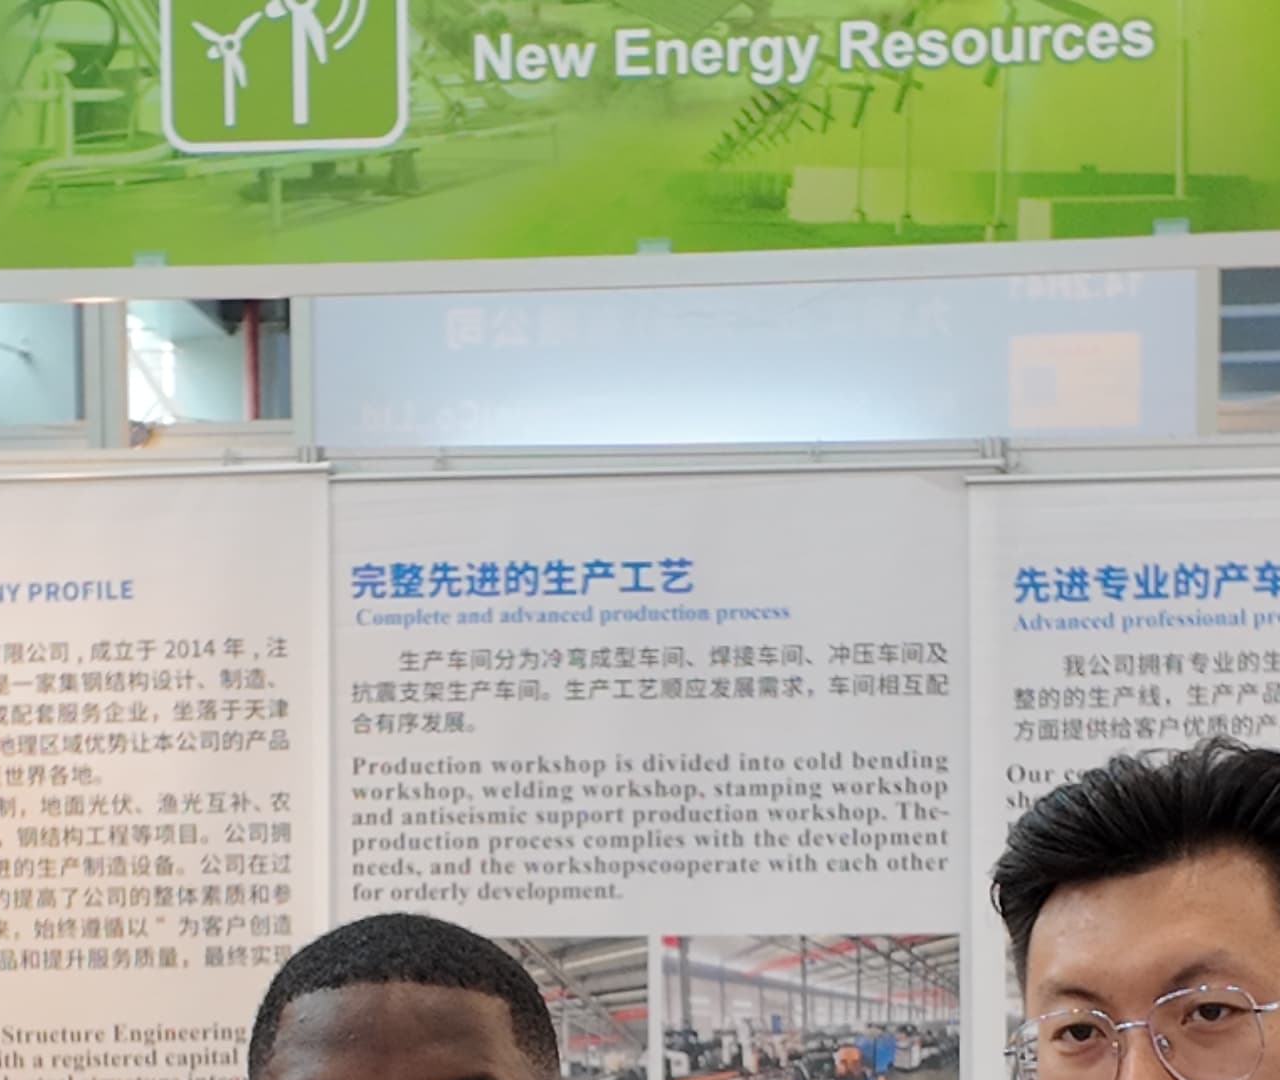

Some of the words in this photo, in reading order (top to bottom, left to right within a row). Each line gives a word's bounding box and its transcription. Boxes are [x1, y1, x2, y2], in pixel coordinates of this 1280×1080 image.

[473, 31, 596, 82] New
[613, 27, 820, 87] Energy
[838, 17, 1156, 70] Resources
[27, 578, 134, 602] PROFILE
[351, 557, 693, 599] 完整先进的生产工艺
[355, 607, 451, 630] Complete
[456, 606, 493, 624] and
[498, 604, 594, 624] advanced
[599, 603, 710, 627] production
[715, 607, 790, 626] process
[1013, 611, 1115, 631] Advanced
[1121, 607, 1247, 634] professional
[352, 755, 482, 776] Production
[491, 754, 606, 778] workshop
[615, 753, 633, 772] is
[641, 752, 730, 772] divided
[739, 752, 785, 771] into
[792, 751, 842, 771] cold
[851, 750, 948, 774] bending
[1006, 766, 1055, 785] Our
[351, 781, 473, 805] workshop,
[481, 780, 573, 802] welding
[581, 778, 705, 802] workshop,
[713, 777, 822, 802] stamping
[831, 775, 948, 800] workshop
[351, 807, 392, 825] and
[401, 805, 527, 825] antiseismic
[535, 807, 624, 829] support
[632, 803, 758, 828] production
[767, 801, 887, 826] workshop.
[351, 831, 479, 856] production
[488, 835, 575, 855] process
[582, 829, 685, 853] complies
[693, 828, 744, 848] with
[753, 828, 789, 848] the
[797, 826, 948, 851] development
[352, 856, 422, 877] needs,
[429, 855, 471, 875] and
[479, 855, 515, 875] the
[523, 855, 760, 879] workshopscooperate
[768, 852, 817, 872] with
[825, 852, 878, 872] each
[885, 852, 948, 872] other
[352, 882, 384, 901] for
[389, 881, 469, 905] orderly
[476, 880, 623, 905] development.
[1, 1026, 104, 1044] Structure
[113, 1021, 247, 1046] Engineering
